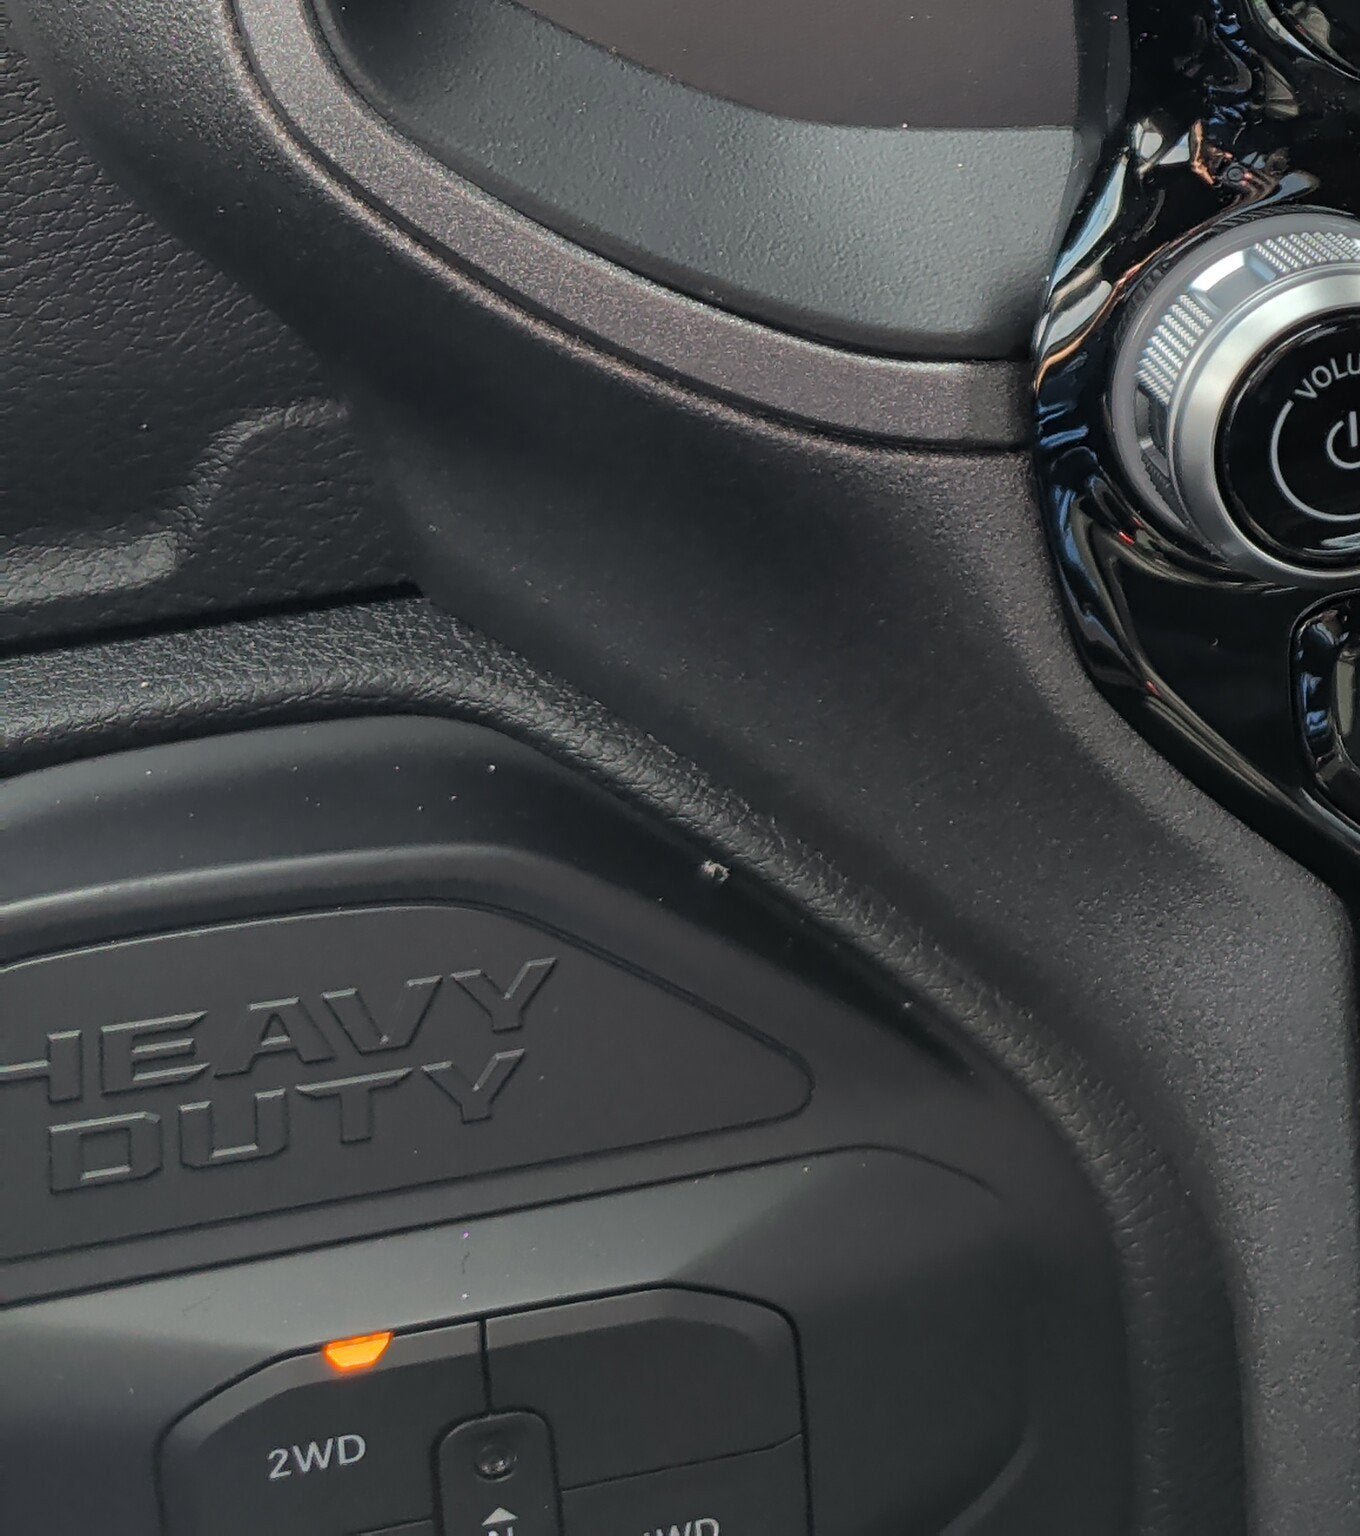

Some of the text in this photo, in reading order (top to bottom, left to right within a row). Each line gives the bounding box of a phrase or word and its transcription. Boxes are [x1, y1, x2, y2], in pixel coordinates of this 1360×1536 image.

[0, 956, 558, 1105] HEAVY
[48, 1047, 525, 1196] DUTY
[266, 1431, 368, 1483] 2WD
